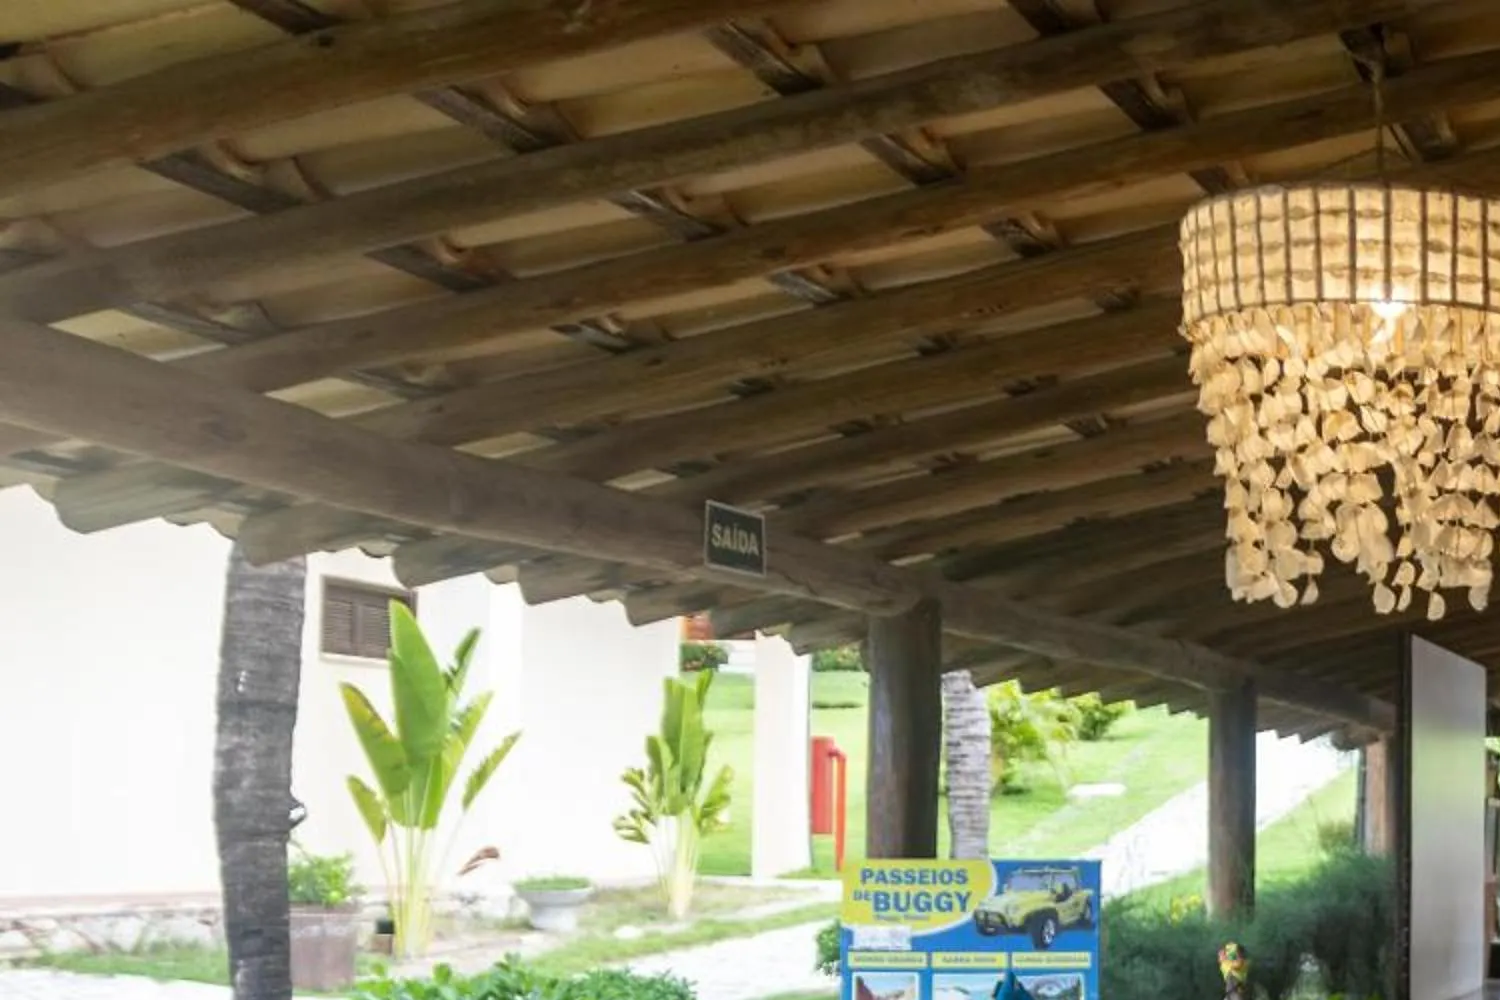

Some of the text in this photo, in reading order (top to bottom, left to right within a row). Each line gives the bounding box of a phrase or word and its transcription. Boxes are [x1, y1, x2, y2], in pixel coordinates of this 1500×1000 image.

[711, 523, 759, 556] SAÍDA
[860, 868, 969, 885] PASSEIOS
[853, 890, 972, 912] DE BUGGY
